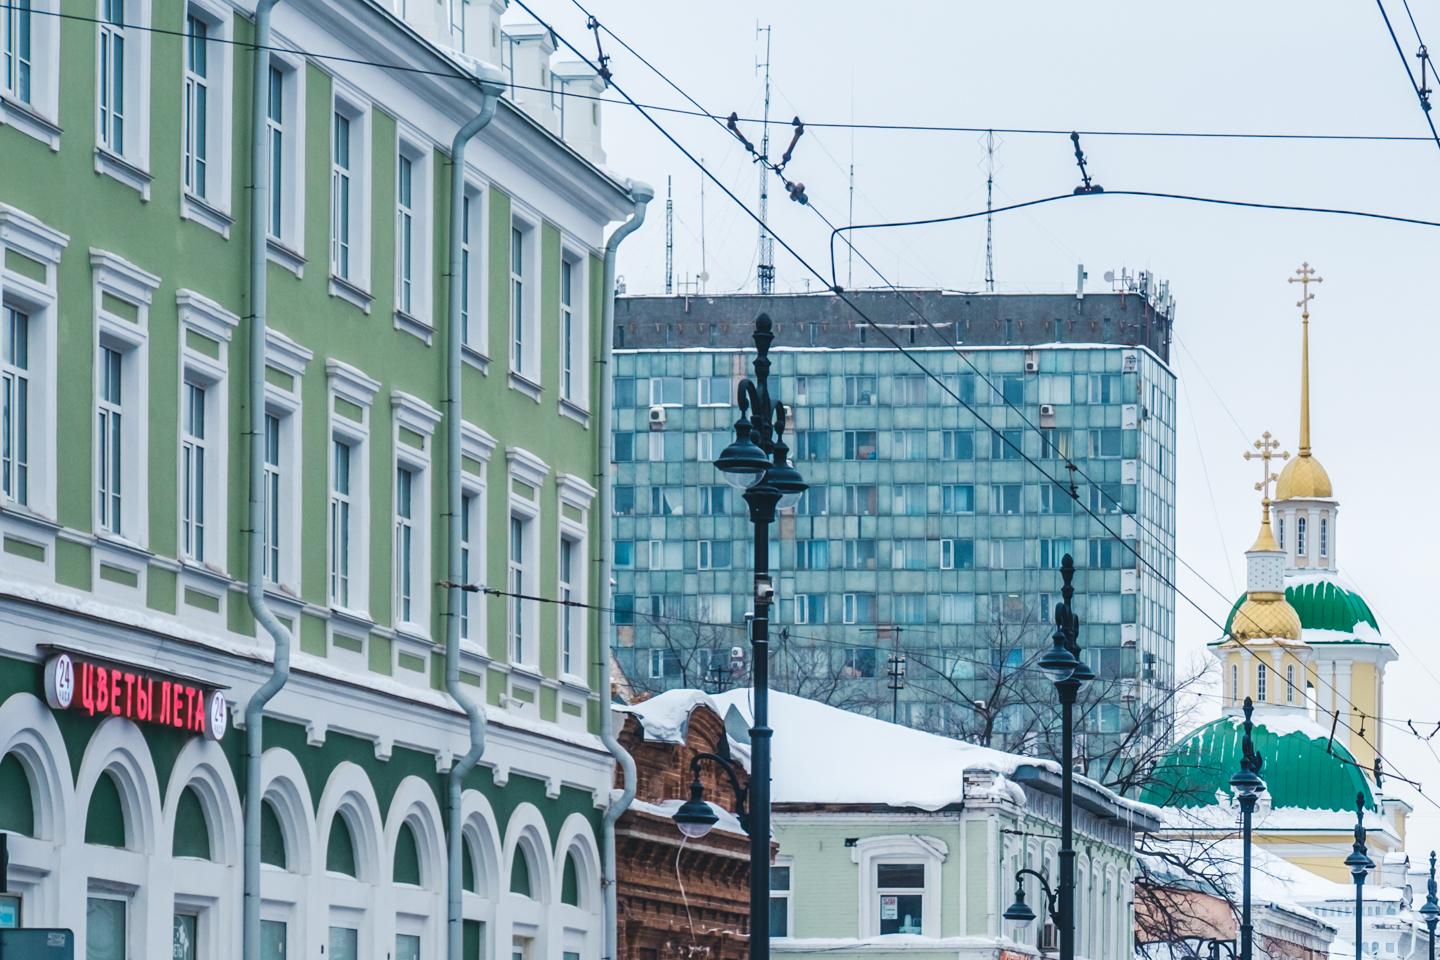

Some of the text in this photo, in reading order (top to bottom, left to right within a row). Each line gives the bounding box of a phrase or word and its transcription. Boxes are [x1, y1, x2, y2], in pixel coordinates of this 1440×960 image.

[59, 659, 70, 688] 24
[82, 662, 205, 732] ЦВЕТЫ ЛЕТА
[214, 693, 224, 722] 24
